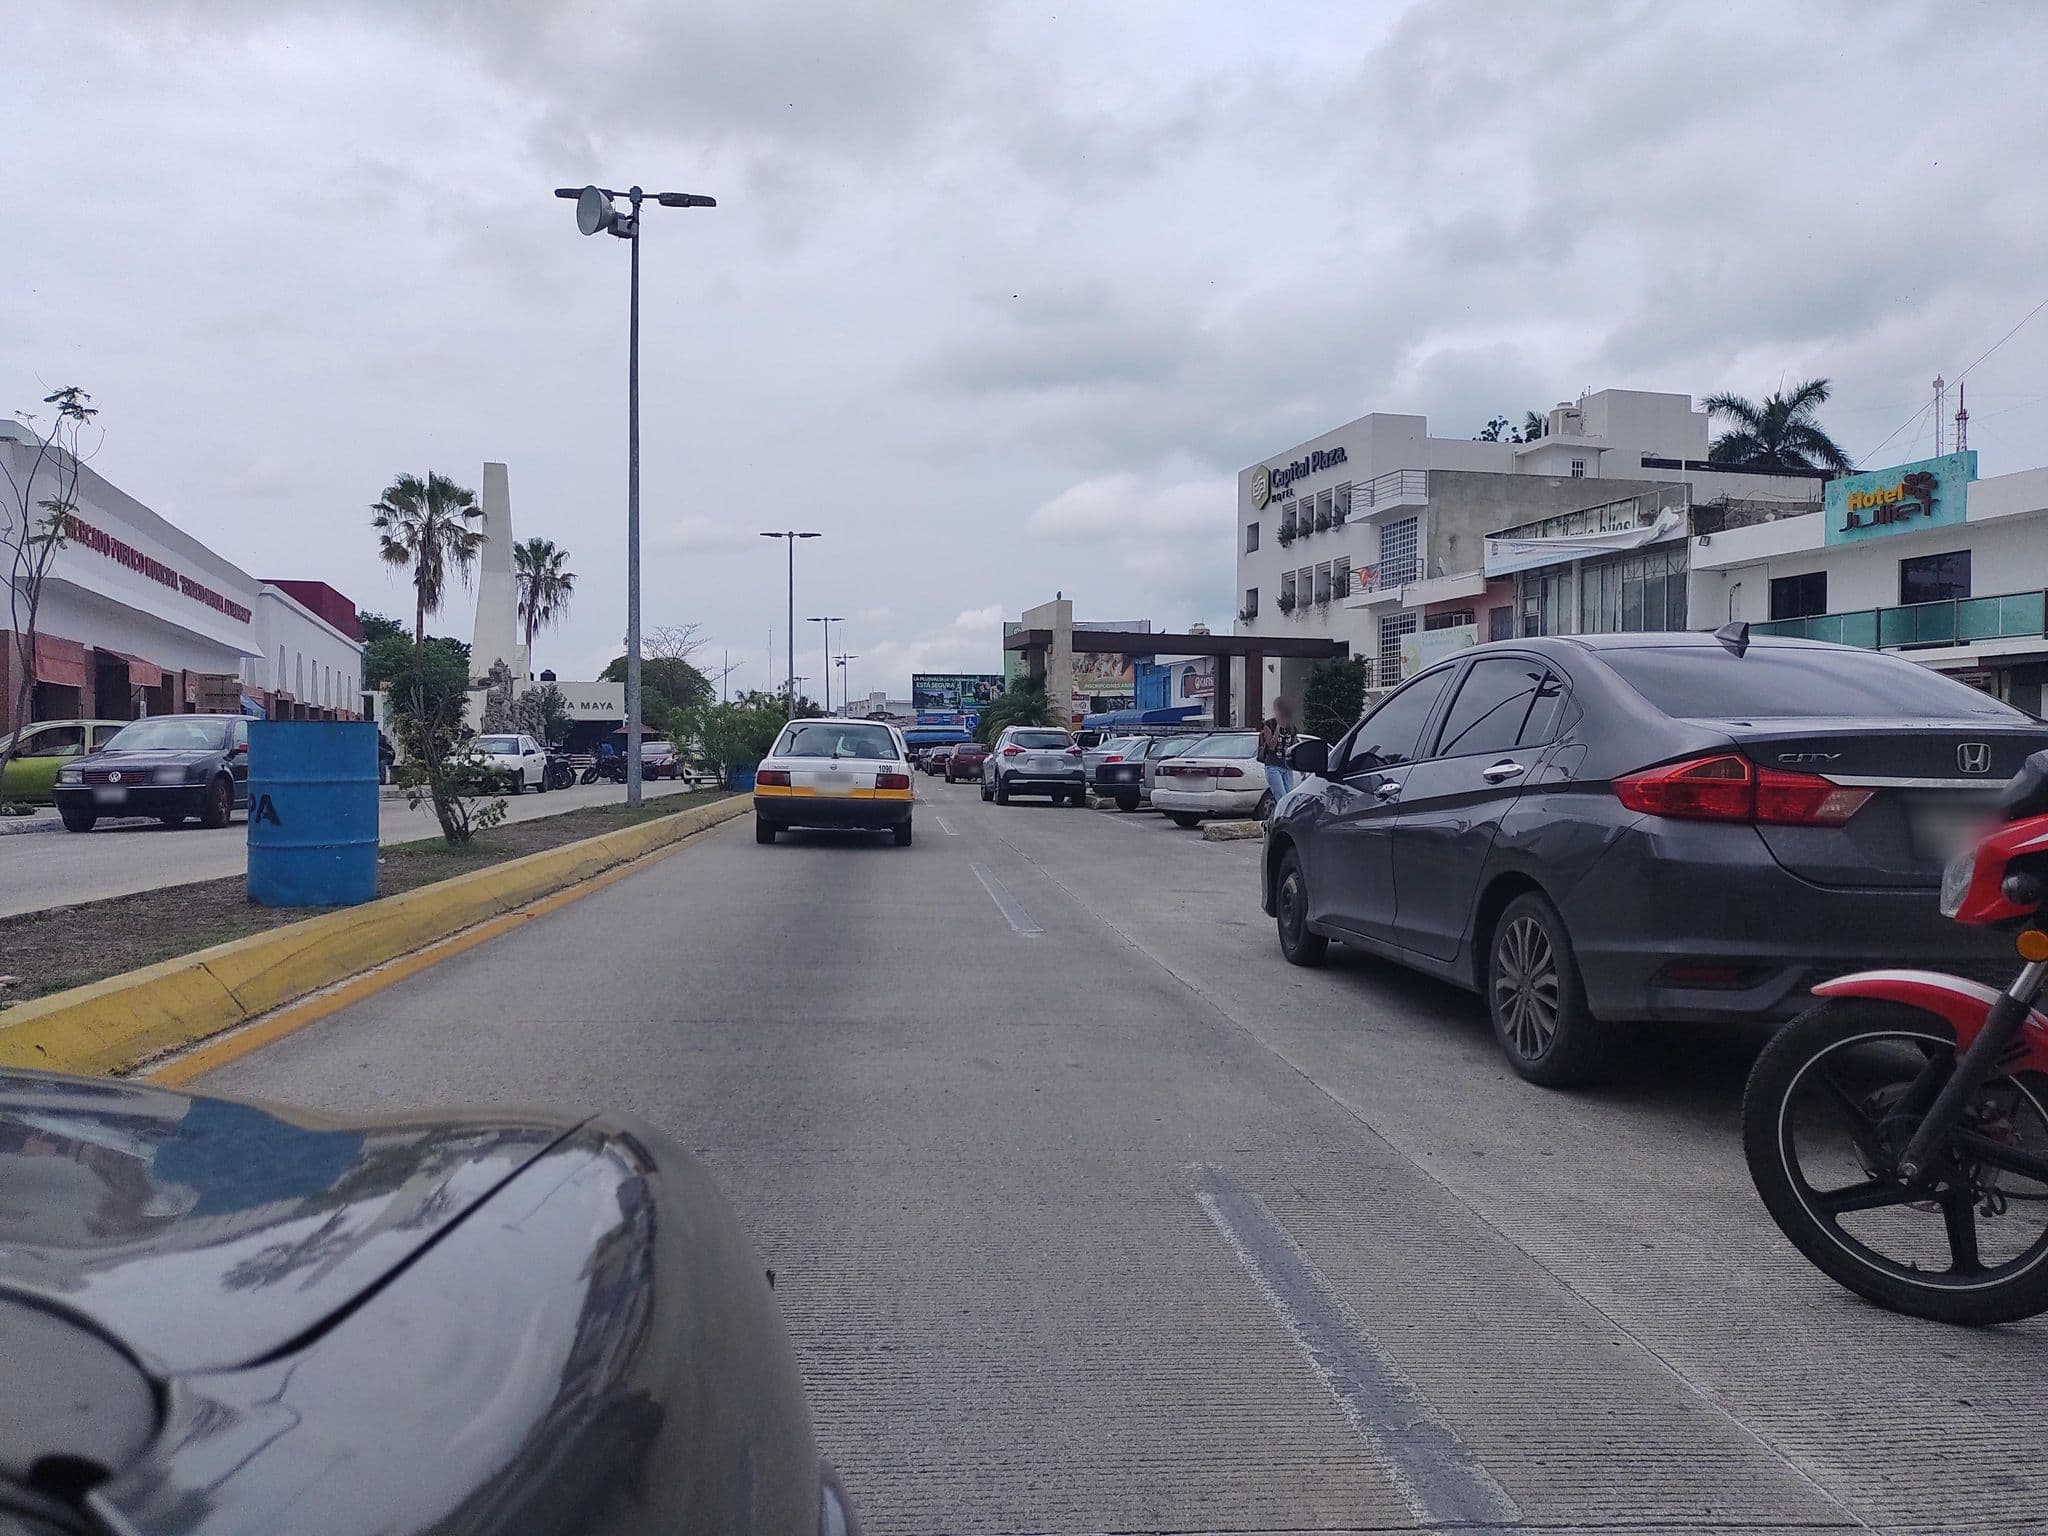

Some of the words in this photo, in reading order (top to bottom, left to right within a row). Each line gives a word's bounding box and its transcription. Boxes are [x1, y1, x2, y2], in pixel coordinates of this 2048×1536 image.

[1272, 456, 1310, 489] Capital
[1847, 482, 1905, 512] Hotel
[581, 702, 614, 711] MAYA
[1777, 752, 1842, 764] CITY
[878, 765, 893, 773] 1090
